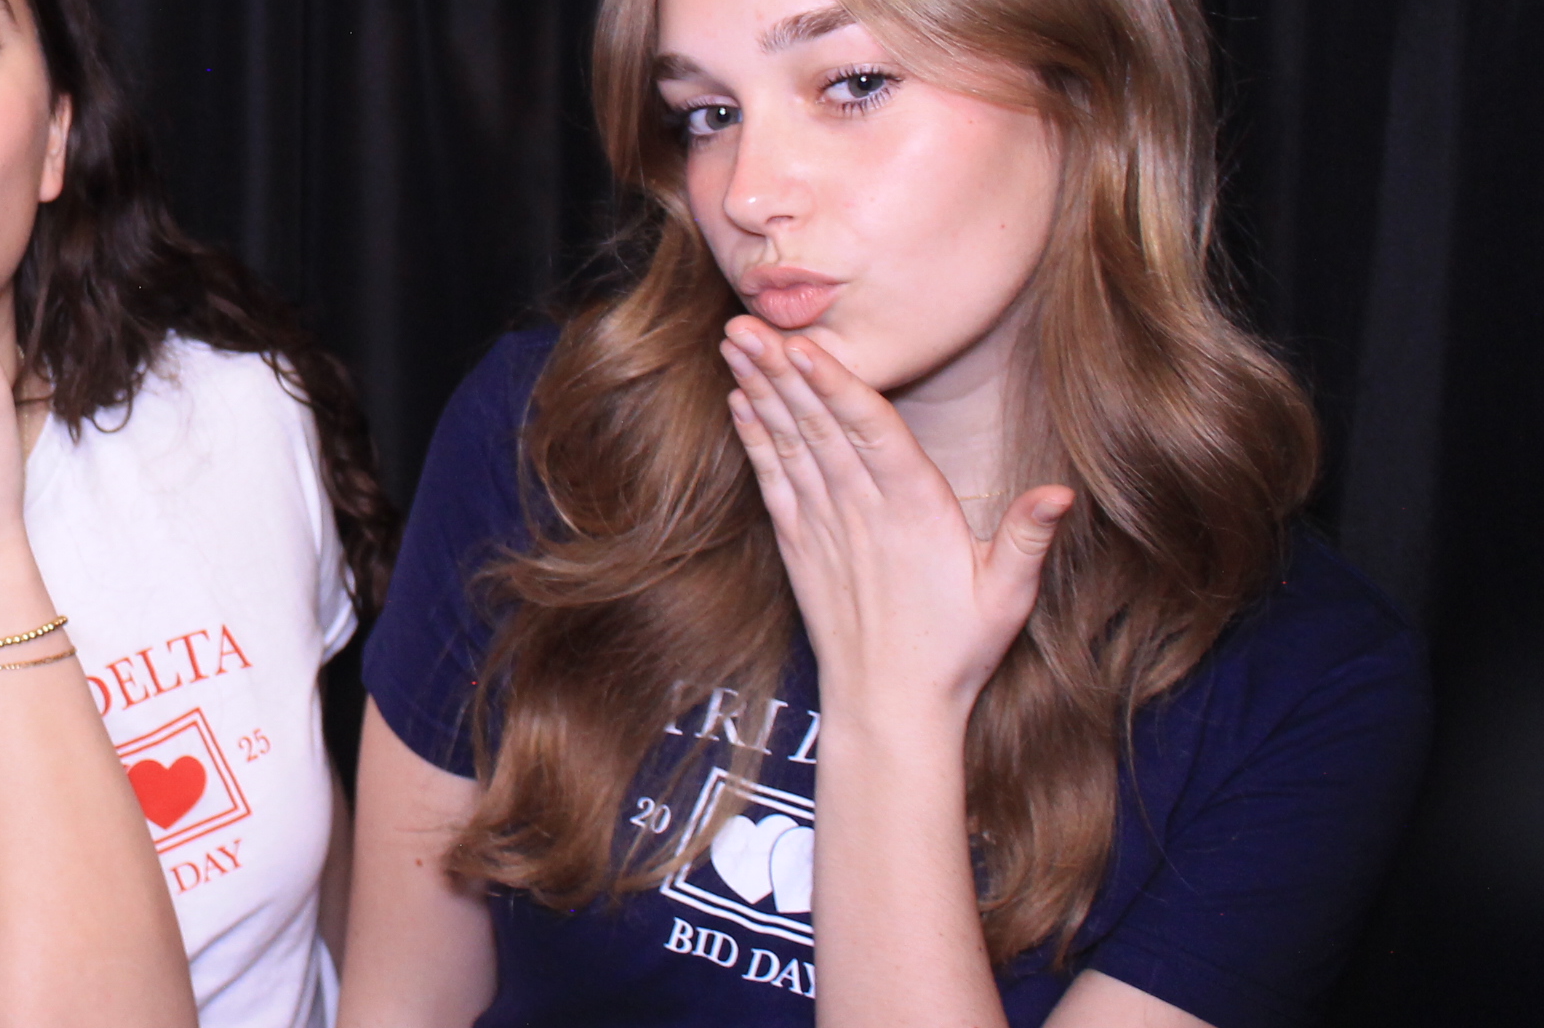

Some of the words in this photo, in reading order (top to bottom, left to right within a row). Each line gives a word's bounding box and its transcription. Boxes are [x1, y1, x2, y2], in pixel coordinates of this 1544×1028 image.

[238, 729, 272, 762] 25
[629, 796, 672, 834] 20
[170, 839, 242, 894] DAY
[663, 916, 740, 968] BID
